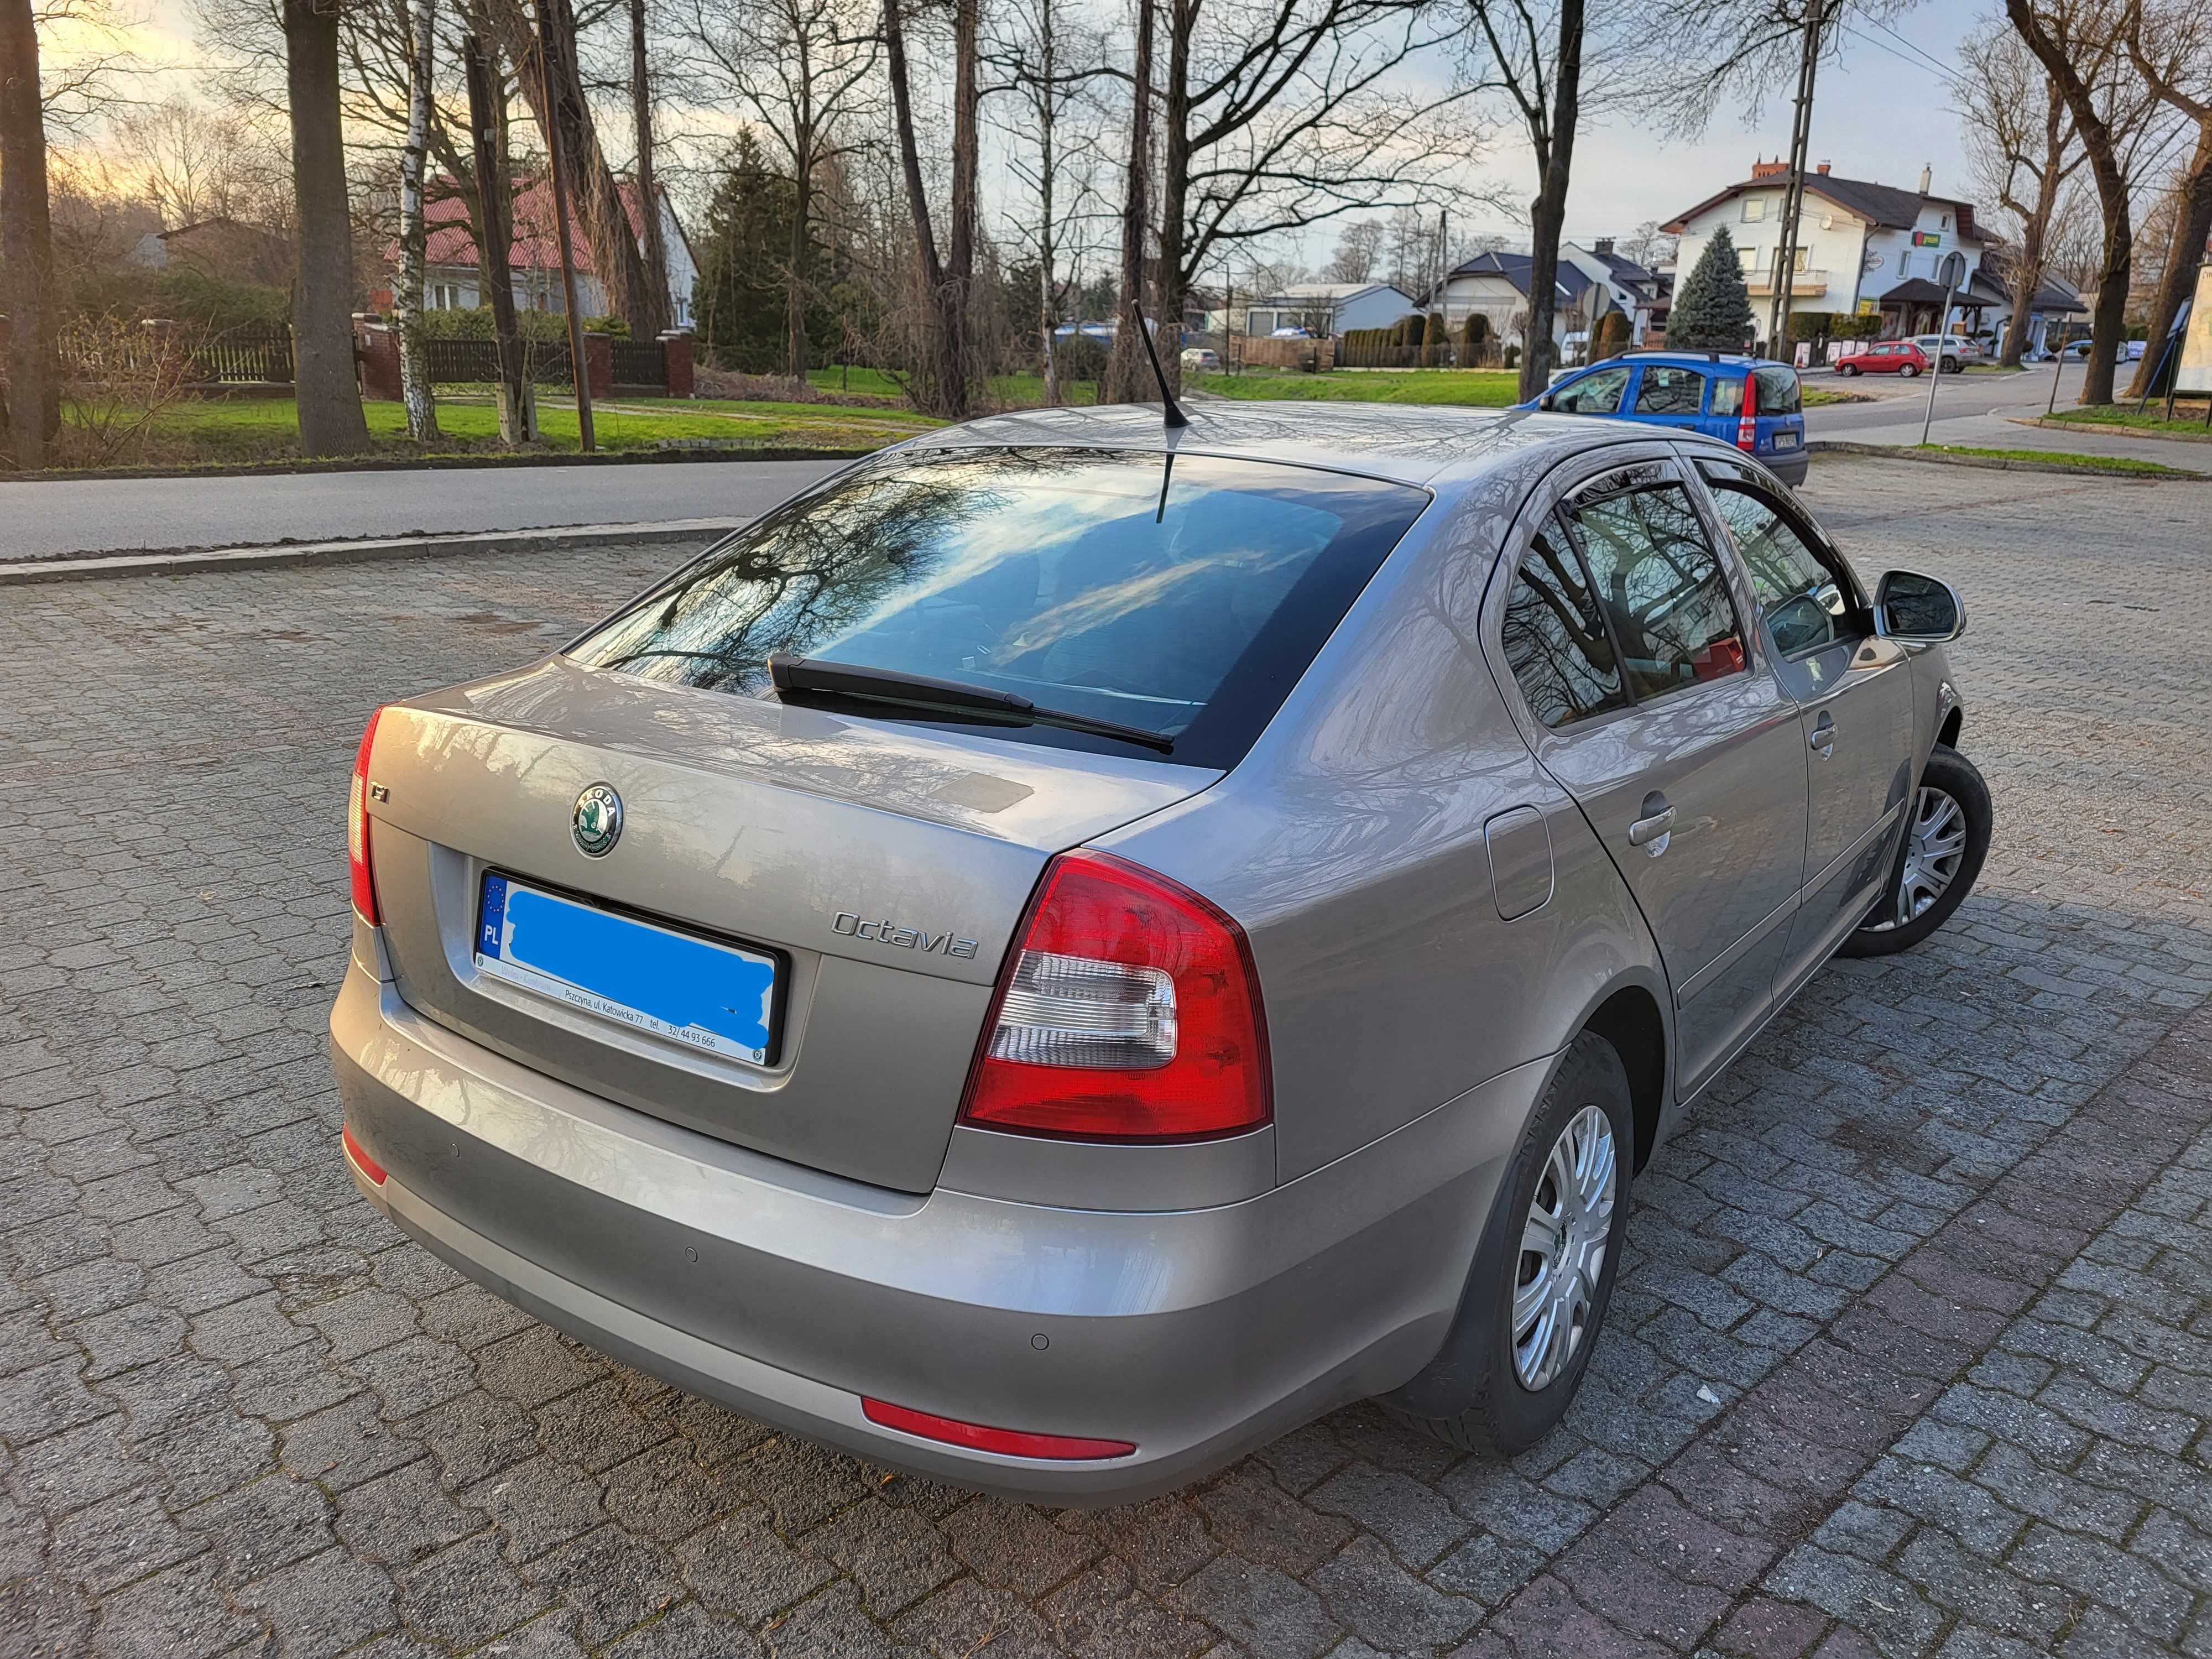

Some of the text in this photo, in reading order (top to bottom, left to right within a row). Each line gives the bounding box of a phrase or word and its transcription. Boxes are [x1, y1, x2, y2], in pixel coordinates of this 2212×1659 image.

[484, 924, 498, 945] PL
[831, 911, 979, 959] Octavia
[565, 989, 592, 1008] Pszczyna,
[602, 1002, 634, 1022] Katowicka
[635, 1014, 644, 1024] 77
[650, 1019, 660, 1030] tel.
[667, 1025, 681, 1037] 32/
[680, 1030, 690, 1040] 44
[691, 1032, 701, 1043] 93
[701, 1036, 716, 1048] 666
